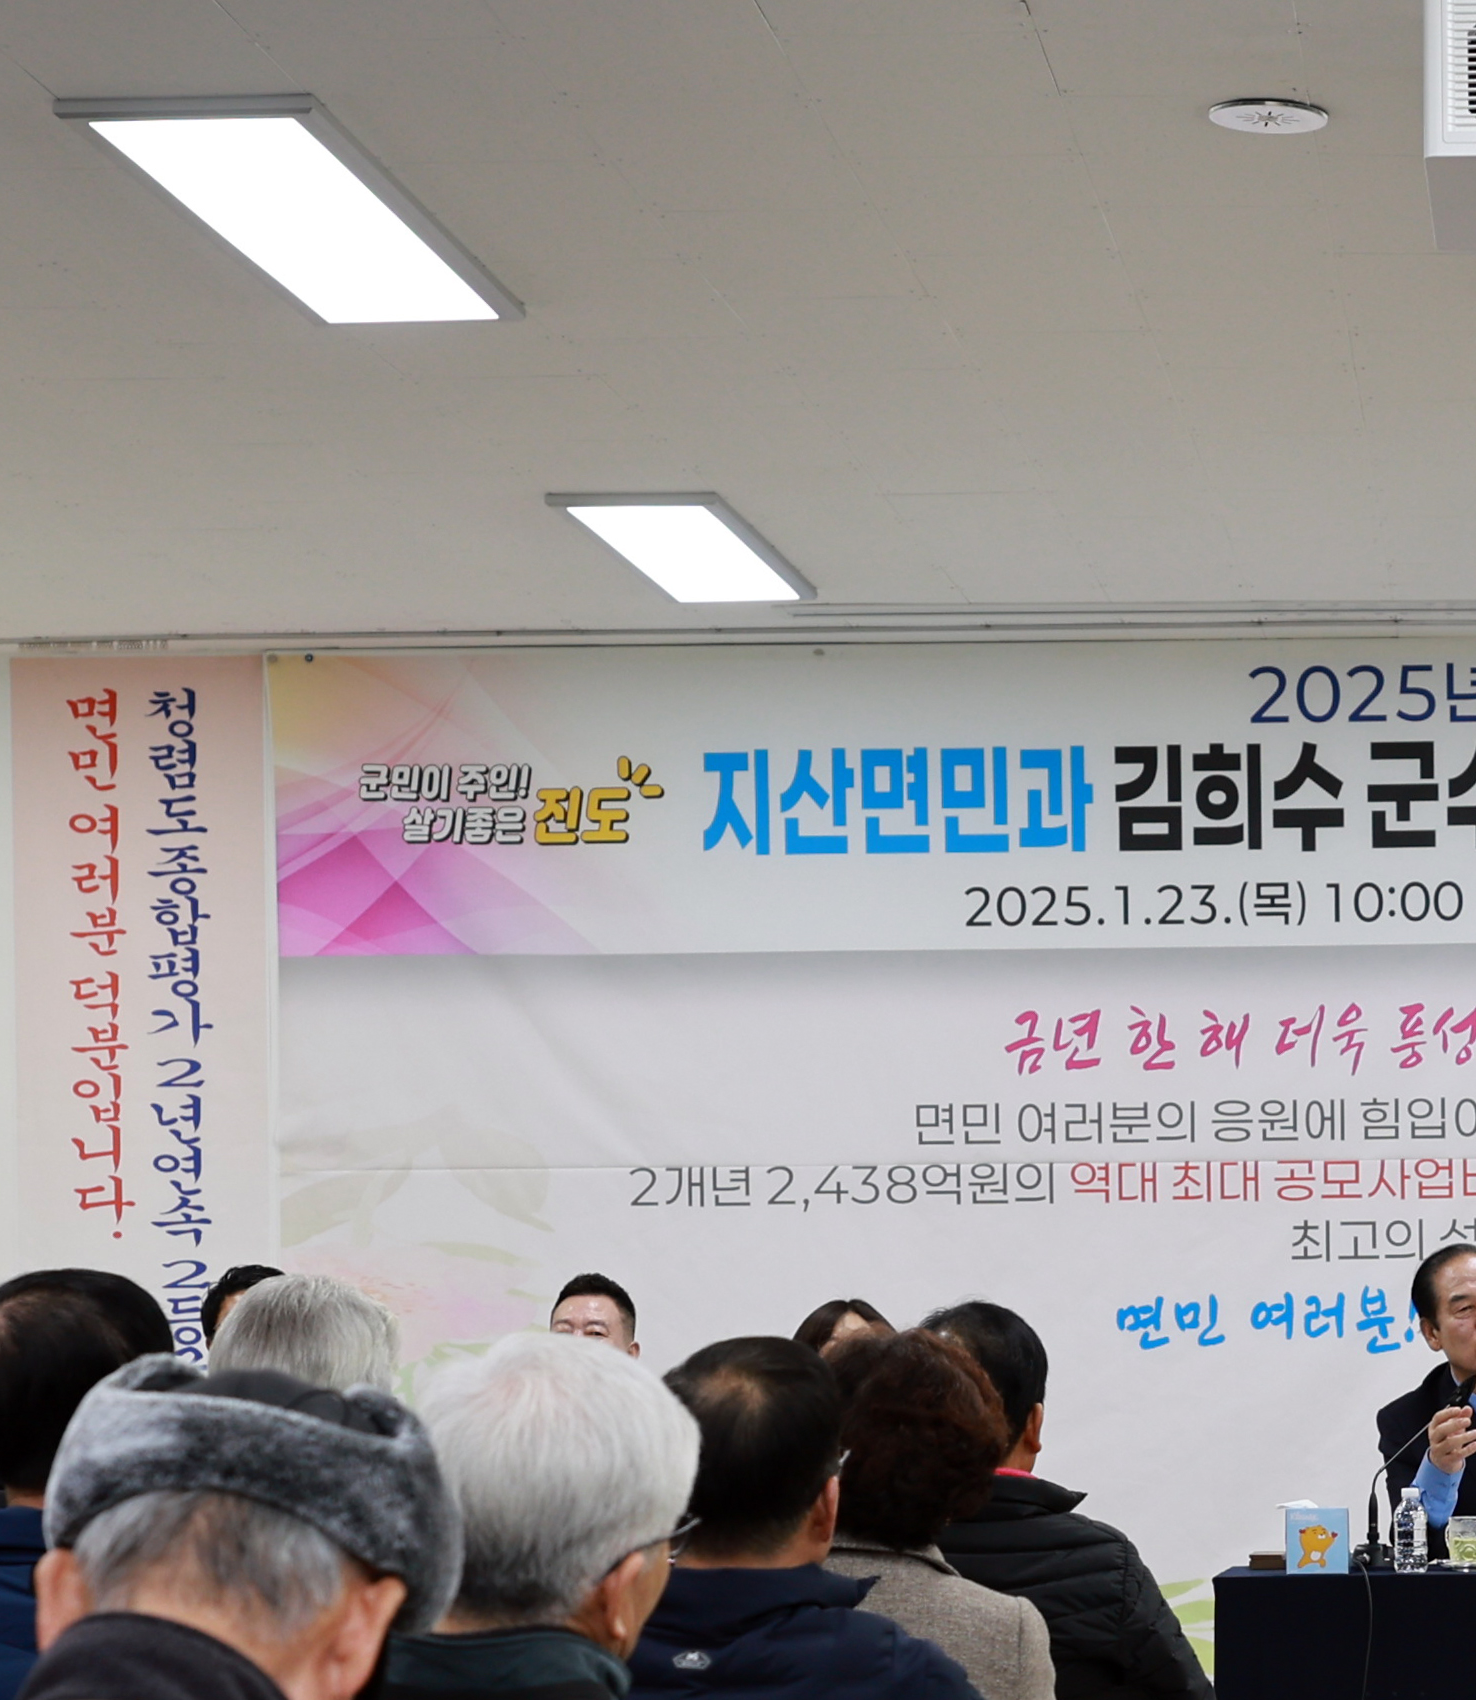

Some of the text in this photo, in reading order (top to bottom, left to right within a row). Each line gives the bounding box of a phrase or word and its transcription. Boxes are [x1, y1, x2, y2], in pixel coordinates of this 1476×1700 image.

[360, 760, 530, 802] 군민이 주인!
[704, 746, 1093, 855] 지산면민과
[1114, 741, 1344, 852] 김희수
[402, 786, 630, 846] 살기좋은 진도
[965, 881, 1463, 926] 2025.1.23.(목) 10:00
[66, 688, 136, 1239] 면민 여러분 덕분입니다.
[1005, 1009, 1101, 1075] 금년
[1128, 1006, 1175, 1071] 한
[1200, 1010, 1249, 1068] 해
[1275, 1003, 1368, 1075] 더욱
[916, 1103, 1001, 1145] 면민
[1018, 1101, 1195, 1144] 여러분의
[1212, 1099, 1345, 1142] 응원에
[630, 1166, 750, 1207] 2개년
[767, 1164, 1054, 1212] 2,438억원의
[1071, 1161, 1157, 1203] 역대
[1173, 1160, 1259, 1202] 최대
[1291, 1219, 1426, 1262] 최고의
[161, 1259, 212, 1371] 2등
[1117, 1294, 1225, 1350] 면민
